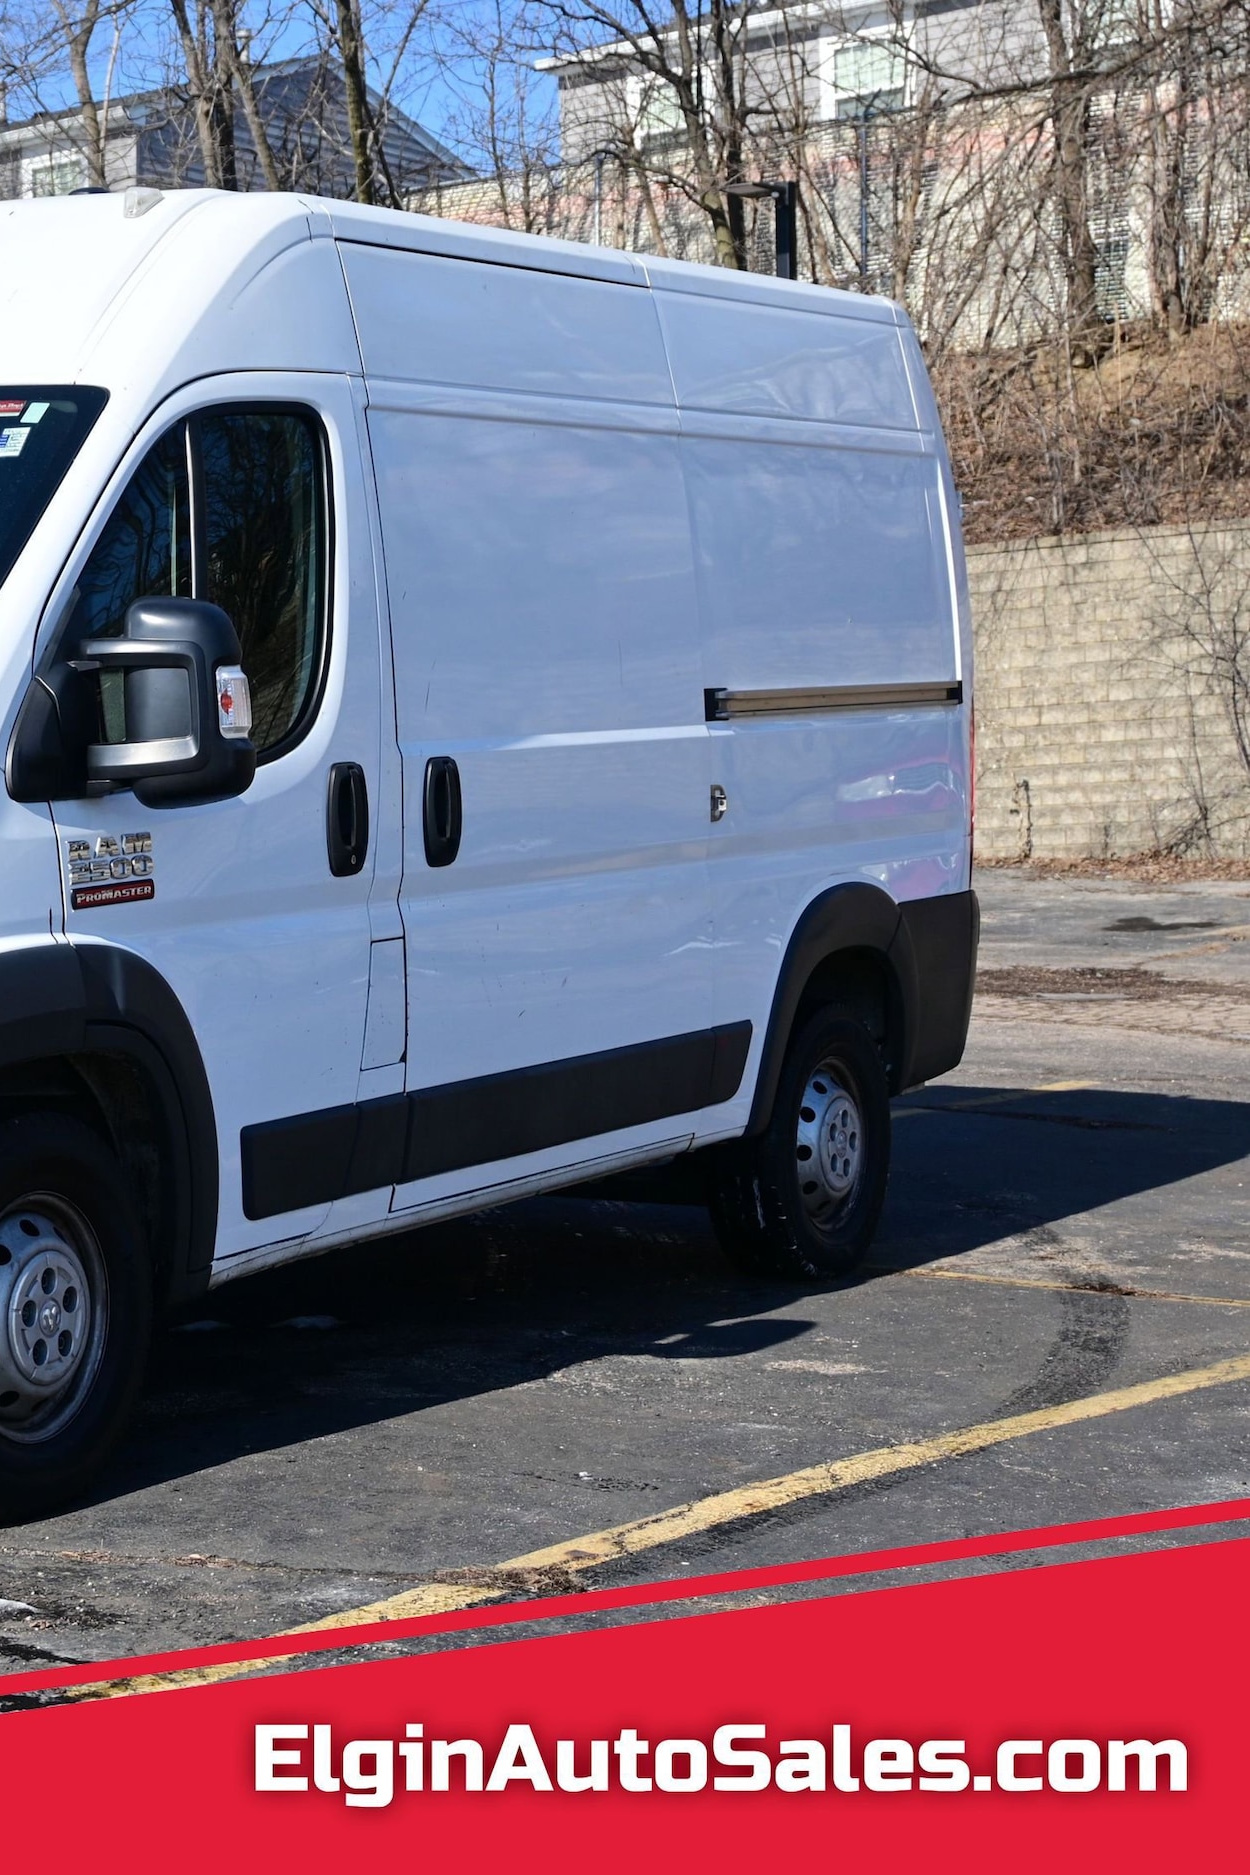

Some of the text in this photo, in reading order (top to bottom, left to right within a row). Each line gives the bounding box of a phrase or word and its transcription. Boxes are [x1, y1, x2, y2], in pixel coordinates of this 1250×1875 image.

[67, 831, 152, 861] RAM
[68, 854, 154, 885] 2500
[75, 885, 152, 904] PROMASTER
